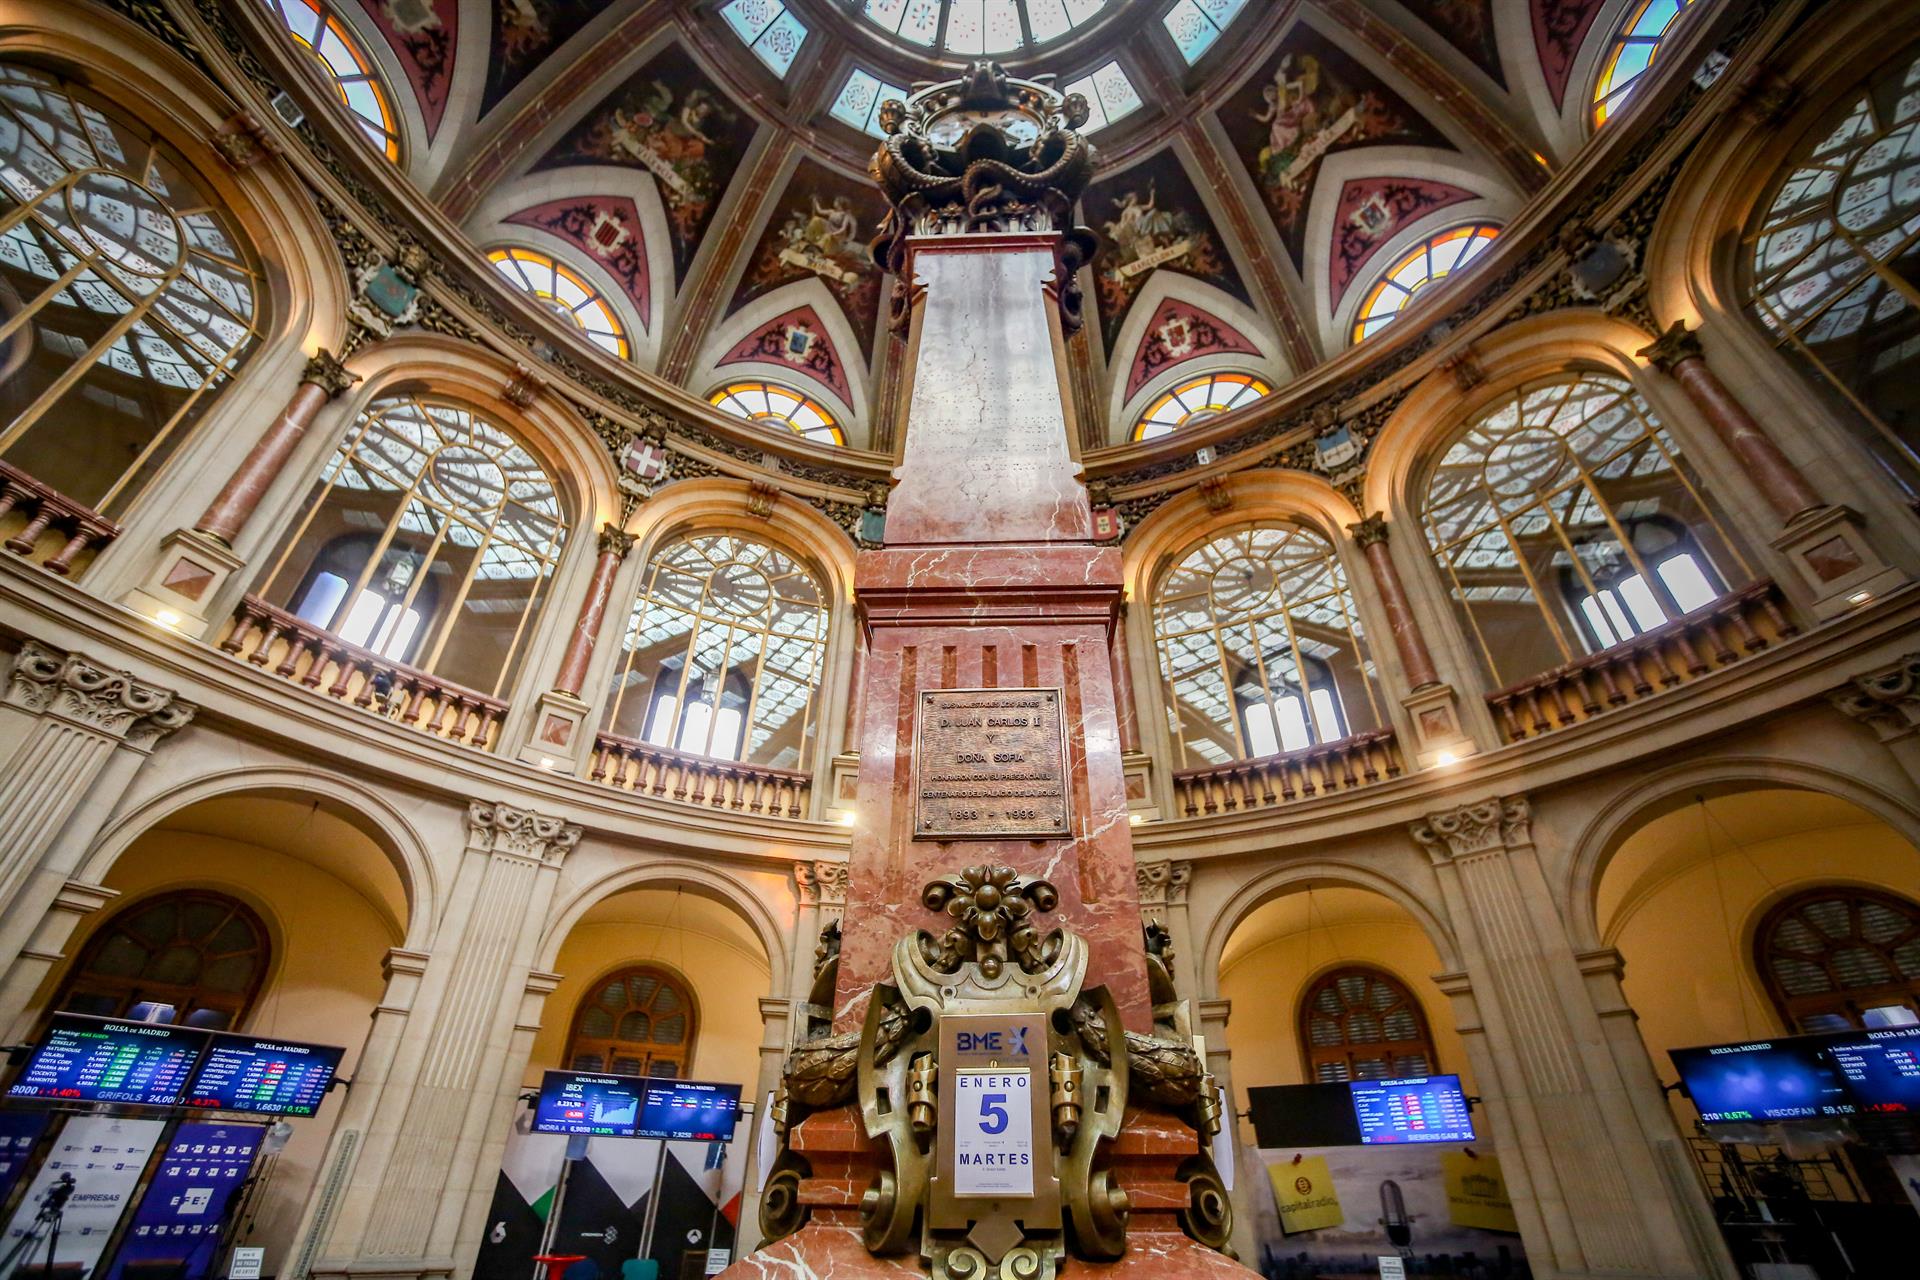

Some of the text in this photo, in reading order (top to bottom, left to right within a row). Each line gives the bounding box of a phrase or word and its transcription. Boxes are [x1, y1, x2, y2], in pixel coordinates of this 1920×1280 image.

[940, 719, 951, 728] D.
[955, 718, 982, 728] JUAN
[987, 718, 1029, 727] CARLOS
[986, 734, 996, 743] Y
[956, 752, 988, 763] DOÑA
[923, 791, 968, 799] CENTENARIO
[949, 810, 978, 820] 1893
[1006, 810, 1037, 820] 1993
[103, 1024, 127, 1034] BOLSA
[138, 1029, 170, 1040] MADRID
[1867, 1031, 1896, 1040] BOLSA
[957, 1032, 1003, 1051] BME
[254, 1043, 276, 1051] BOLSA
[282, 1046, 310, 1054] MADRID
[1709, 1047, 1731, 1055] BOLSA
[1739, 1043, 1772, 1053] MADRID
[565, 1083, 584, 1092] IBEX
[960, 1077, 1027, 1088] ENERO
[97, 1091, 144, 1102] GRIFOLS
[233, 1101, 250, 1110] IAG
[979, 1094, 1009, 1135] 5
[1764, 1106, 1816, 1117] VISCOFAN
[538, 1124, 560, 1132] INDRA
[959, 1153, 1029, 1165] MARTES
[72, 1194, 120, 1202] EMPRESAS
